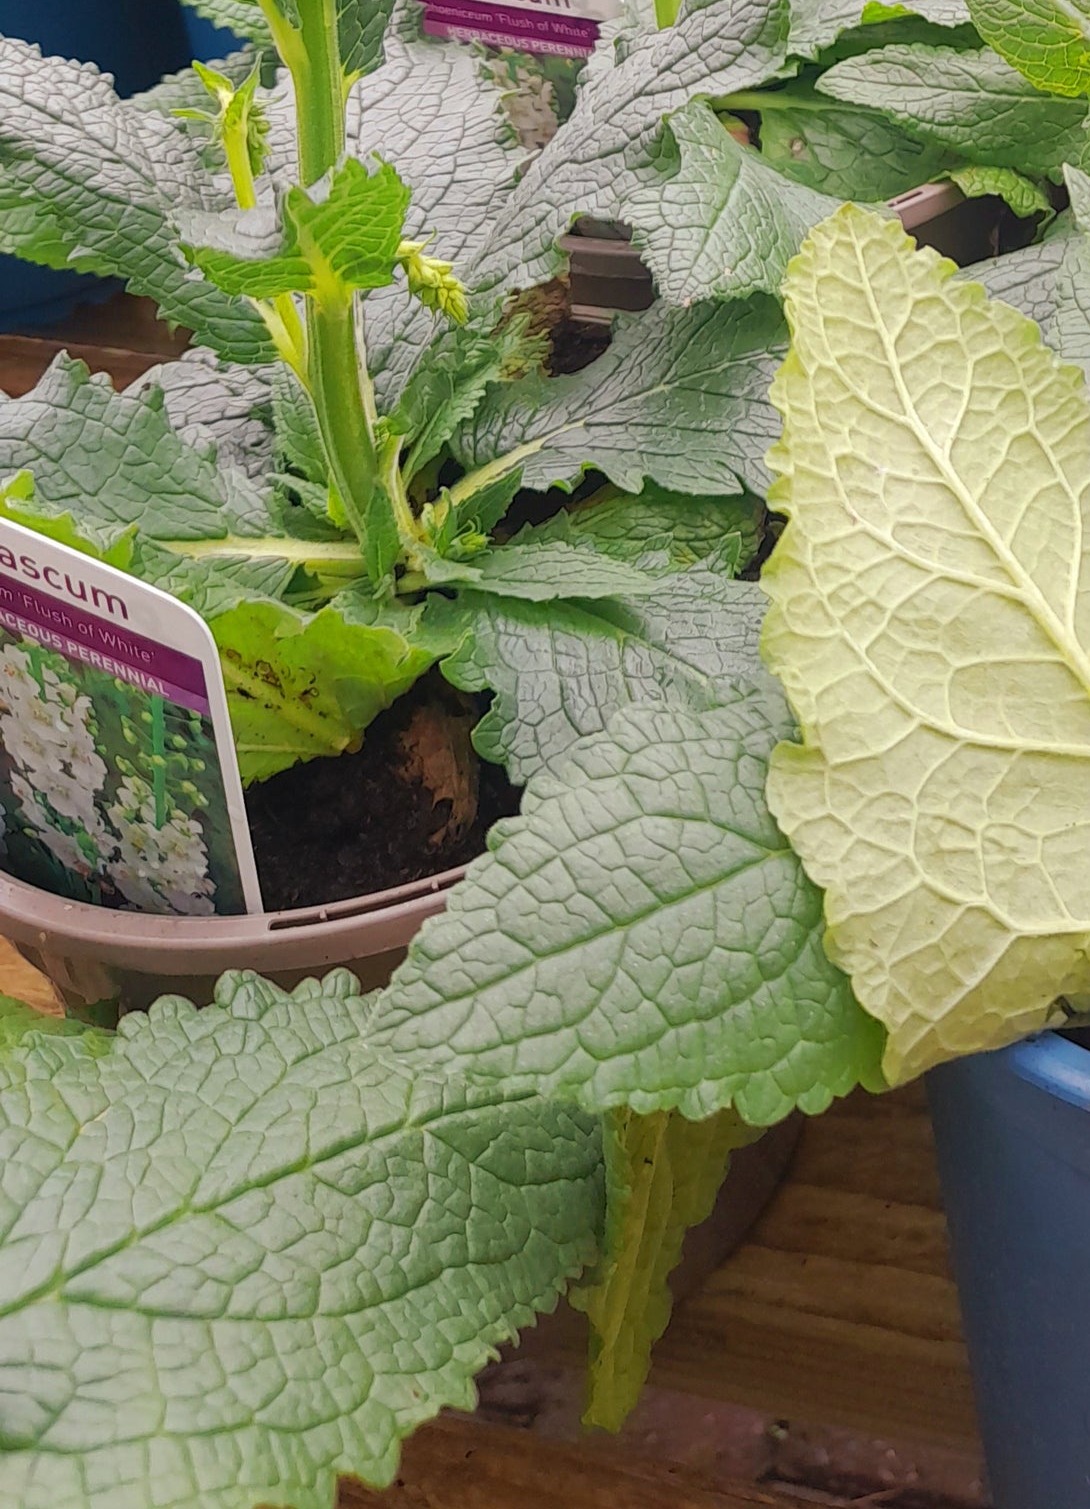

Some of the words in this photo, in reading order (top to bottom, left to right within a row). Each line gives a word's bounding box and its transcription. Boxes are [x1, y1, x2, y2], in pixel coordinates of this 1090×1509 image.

[495, 11, 535, 29] 'Flush
[536, 21, 550, 32] of
[531, 40, 593, 59] PERENNI
[0, 546, 129, 621] ascum
[16, 590, 73, 629] 'Flush
[77, 621, 94, 638] of
[97, 627, 157, 664] White'
[66, 640, 171, 697] PERENNIAL
